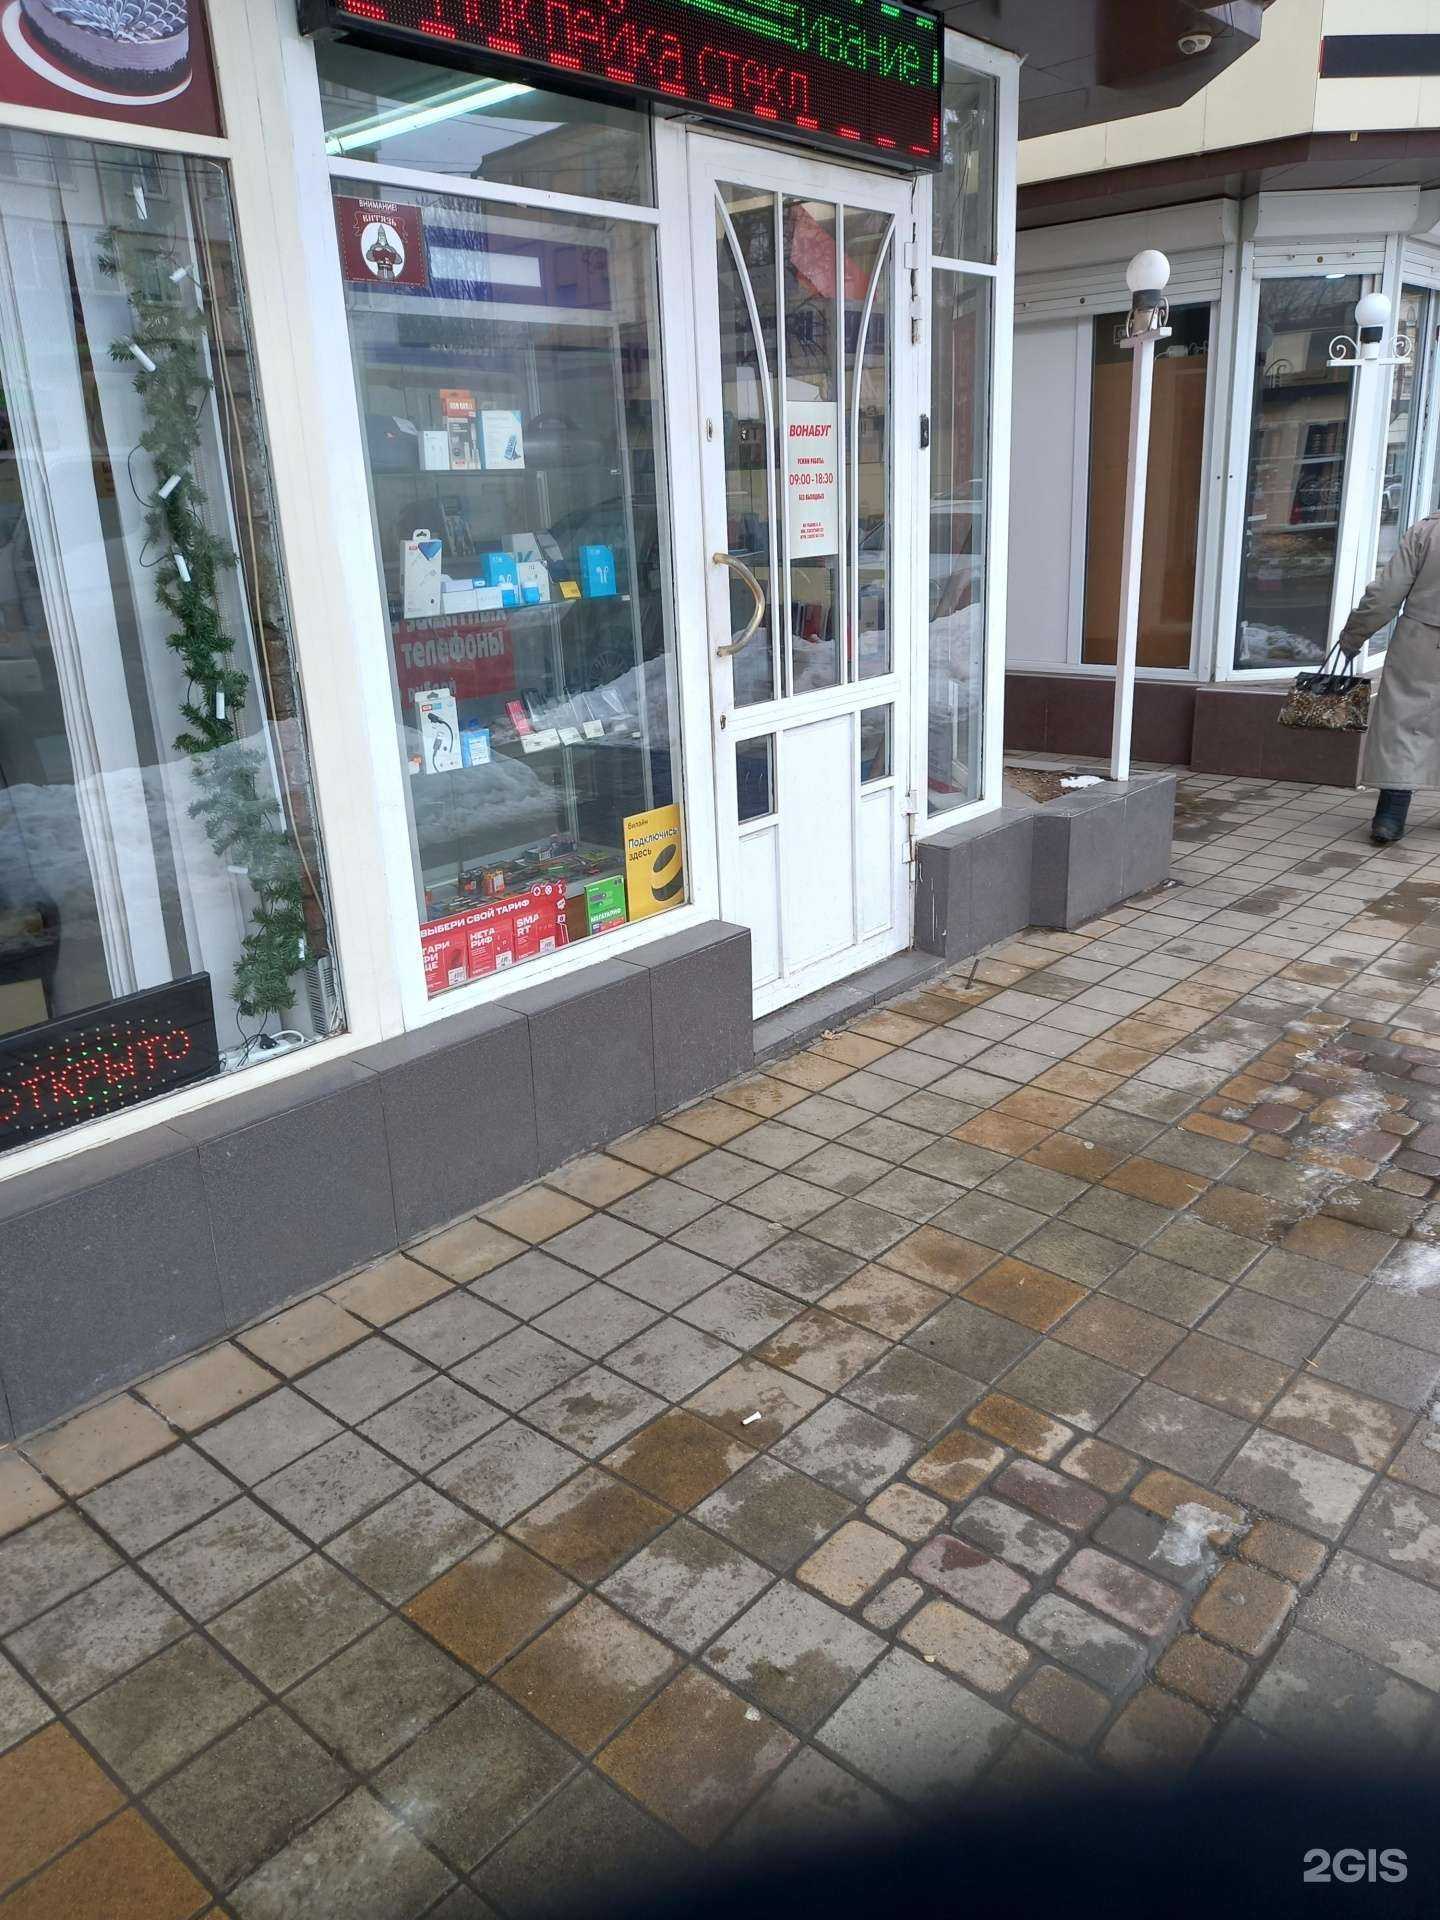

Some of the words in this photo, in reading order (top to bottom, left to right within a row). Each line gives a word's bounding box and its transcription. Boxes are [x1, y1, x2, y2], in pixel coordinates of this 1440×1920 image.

[789, 424, 832, 437] ВОНАБУГ
[629, 848, 652, 861] здесь
[420, 918, 466, 938] ВЫБЕРИ
[466, 909, 496, 924] СВОЙ
[496, 899, 530, 914] ТАРИФ
[471, 936, 493, 949] РИФ
